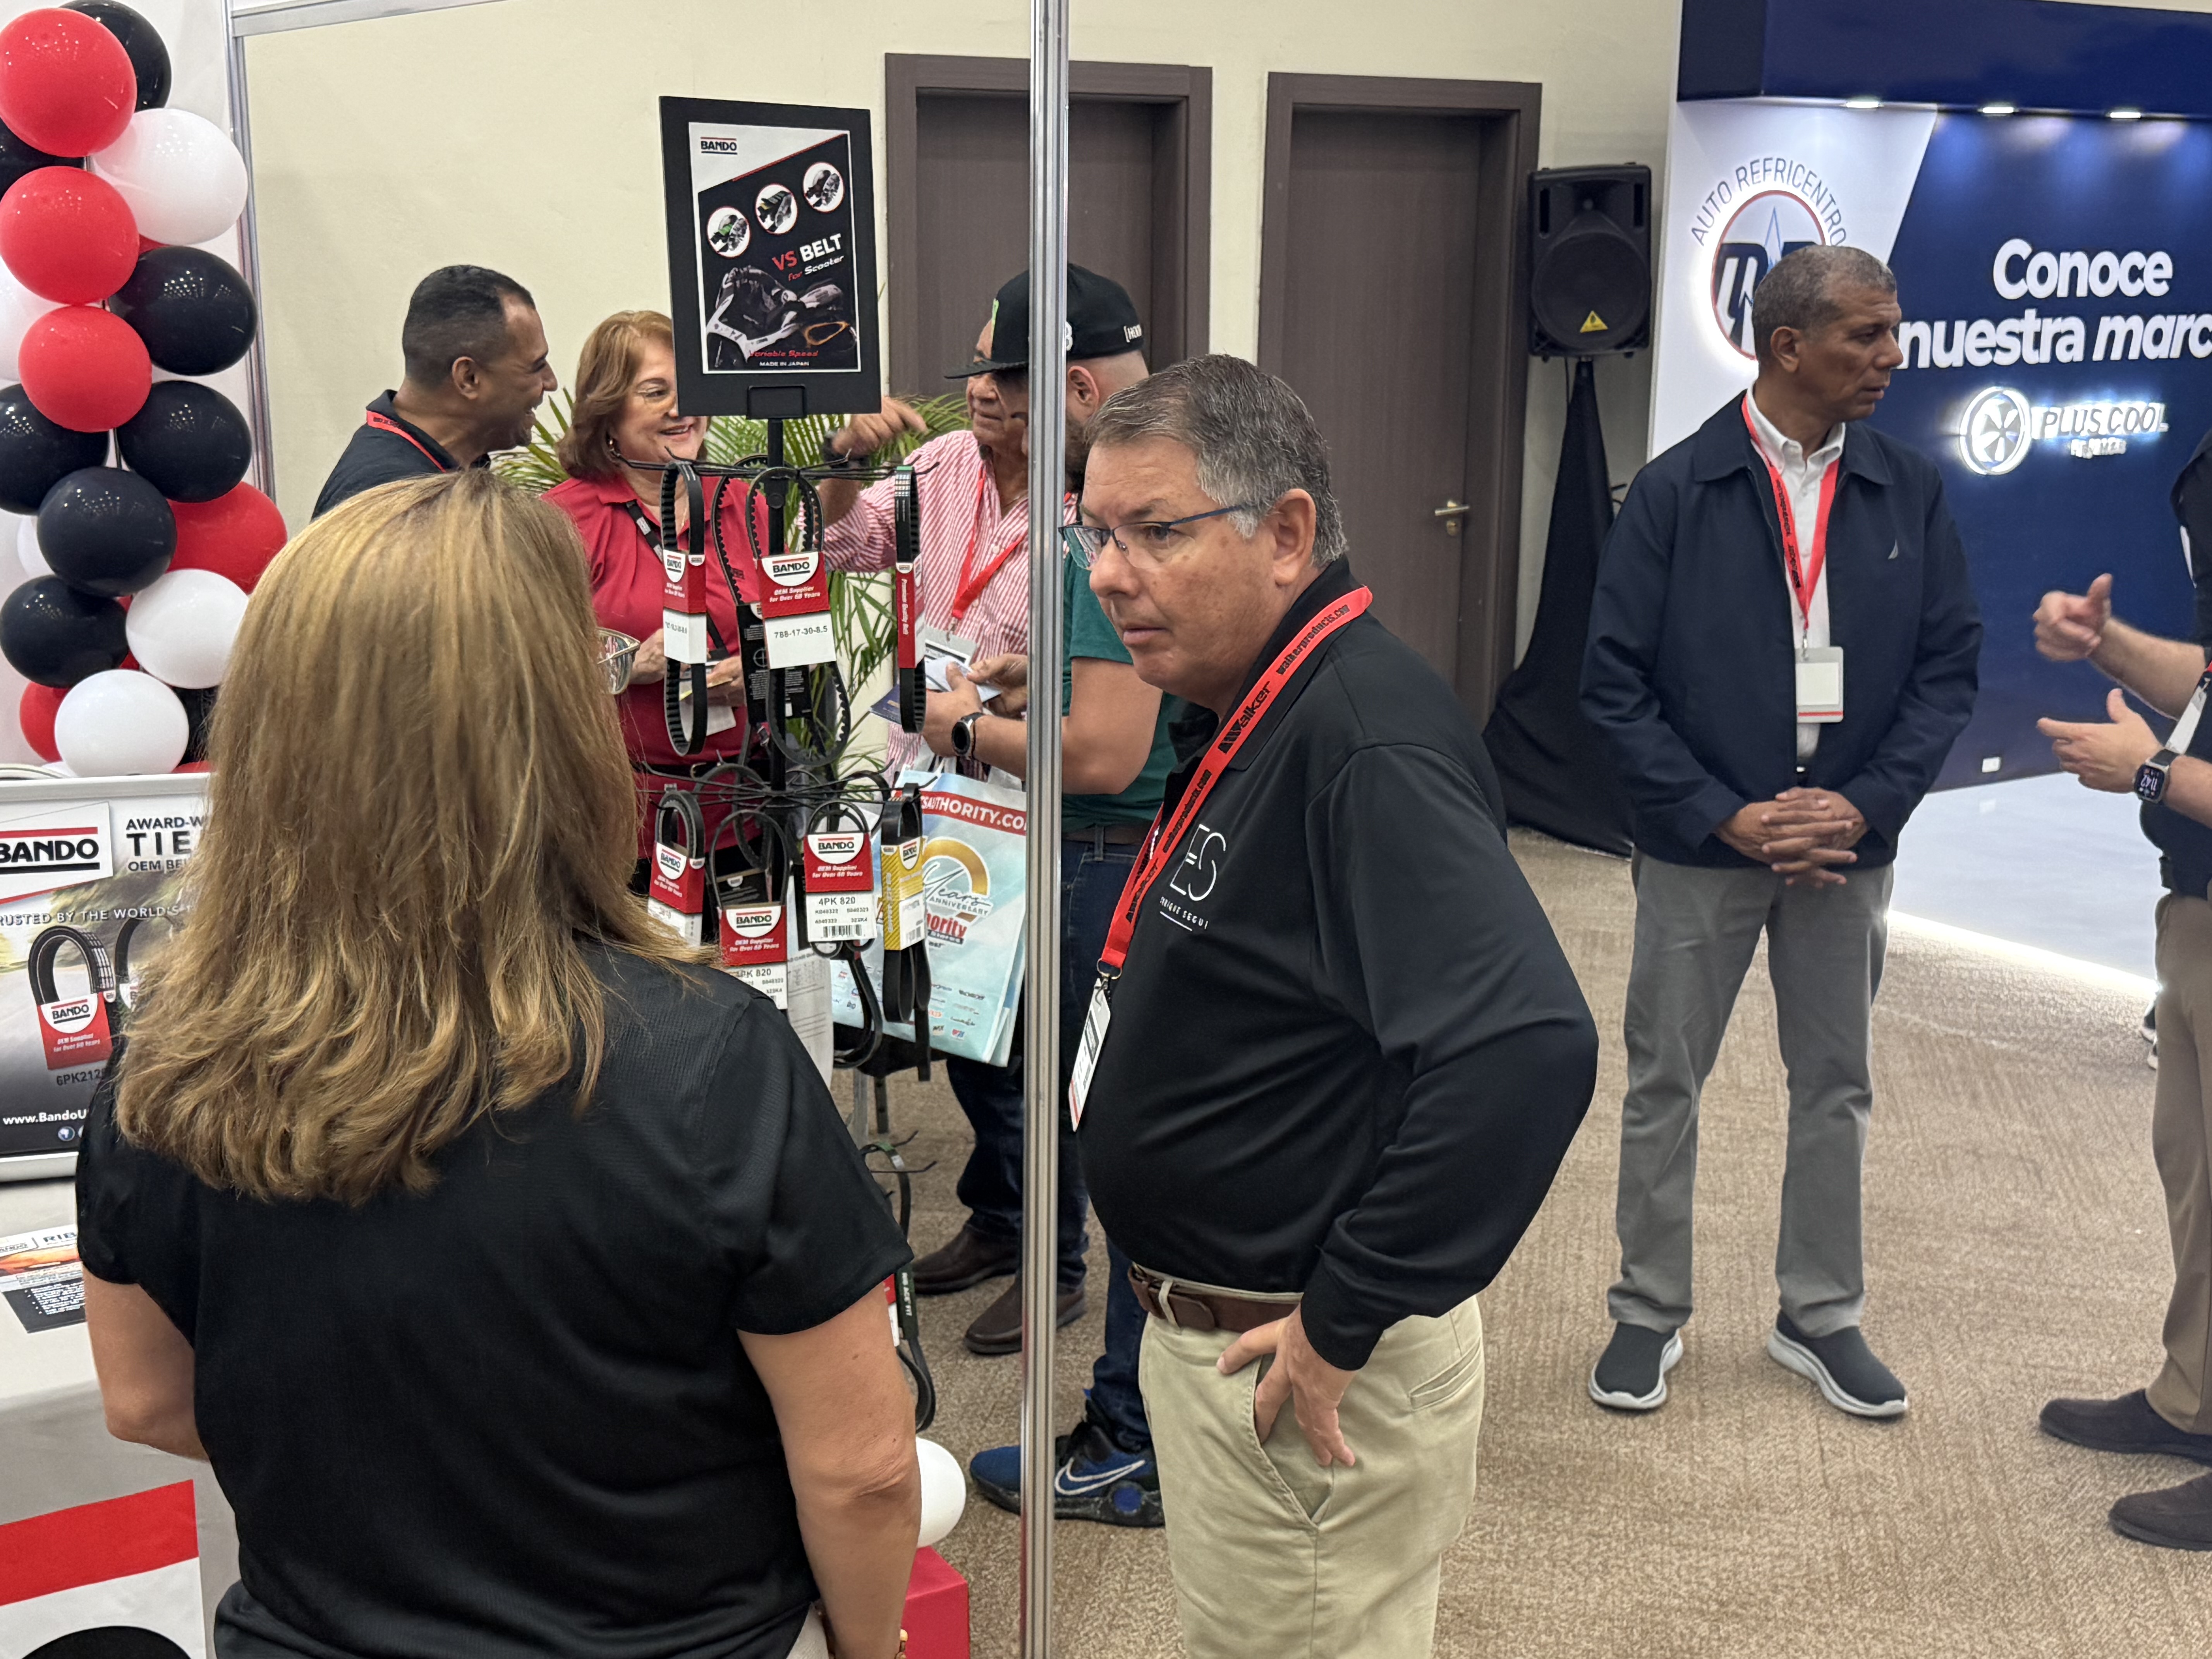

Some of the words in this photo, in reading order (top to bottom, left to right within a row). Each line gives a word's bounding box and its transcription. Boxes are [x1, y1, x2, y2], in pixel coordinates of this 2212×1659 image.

[701, 141, 737, 151] BANDO
[1691, 180, 1732, 247] AUTO
[772, 247, 798, 271] VS
[800, 233, 841, 262] BELT
[788, 271, 803, 282] for
[805, 255, 845, 275] Scooter
[1993, 238, 2174, 300] Conoce
[1896, 309, 2086, 369] nuestra
[2092, 313, 2212, 362] marc
[2040, 408, 2103, 439] PLUS
[2107, 403, 2169, 435] COOL
[773, 561, 810, 573] BANDO
[1218, 680, 1271, 754] Walker
[0, 838, 99, 863] BANDO
[126, 831, 192, 856] TIE
[818, 842, 855, 850] BANDO
[128, 860, 161, 871] OEM
[661, 852, 681, 869] BANDO
[819, 897, 837, 906] 4PK
[840, 896, 856, 905] 820
[929, 896, 988, 916] ANNIVERSARY
[57, 911, 75, 923] BY
[82, 910, 109, 922] THE
[114, 906, 180, 919] WORLD'S
[737, 915, 772, 925] BANDO
[52, 1004, 89, 1020] BANDO
